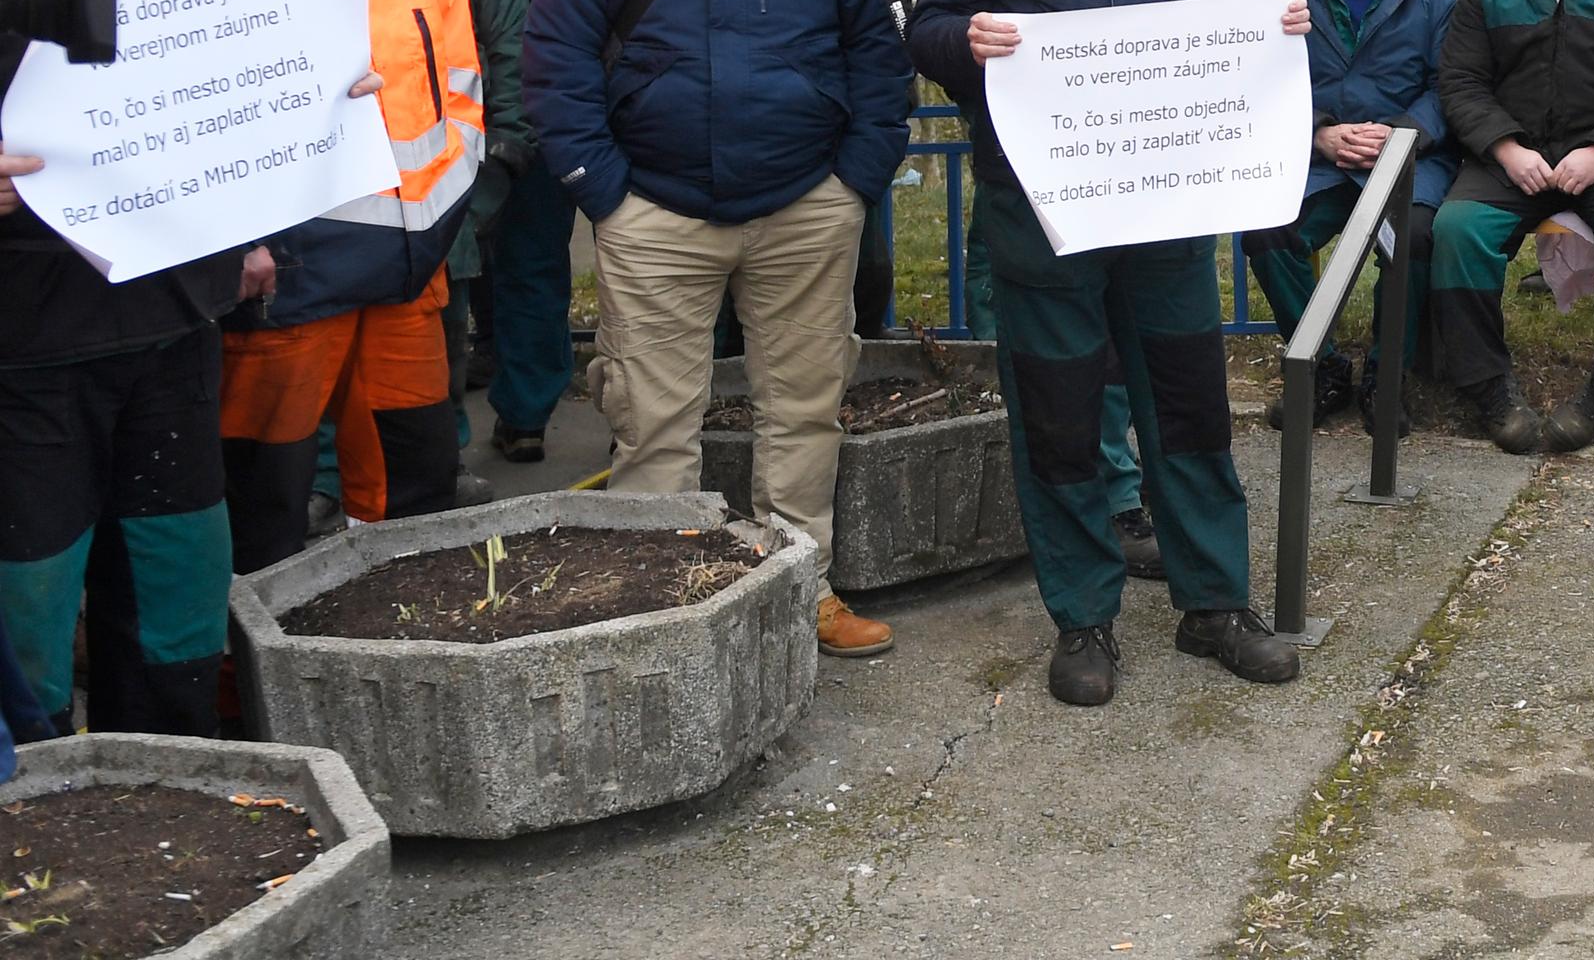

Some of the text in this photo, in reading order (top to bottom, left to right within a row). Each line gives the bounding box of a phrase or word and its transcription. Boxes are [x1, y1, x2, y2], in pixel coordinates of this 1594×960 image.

[117, 31, 209, 62] verejnom
[213, 10, 279, 39] záujme
[1041, 27, 1264, 61] Mestská doprava je službou
[83, 50, 314, 128] To, čo si mesto objedná,
[1065, 56, 1241, 87] vo verejnom záujme !
[92, 139, 140, 166] malo
[144, 132, 166, 152] by
[173, 121, 191, 145] aj
[194, 97, 262, 136] zaplatiť
[268, 90, 311, 113] včas
[1050, 95, 1250, 132] To, čo si mesto objedná,
[1050, 122, 1253, 160] malo by aj zaplatiť včas !
[62, 205, 100, 226] Bez
[106, 179, 175, 215] dotácií
[180, 178, 200, 196] sa
[204, 160, 249, 188] MHD
[255, 142, 299, 172] robiť
[1033, 161, 1283, 205] Bez dotácií sa MHD robiť nedá !
